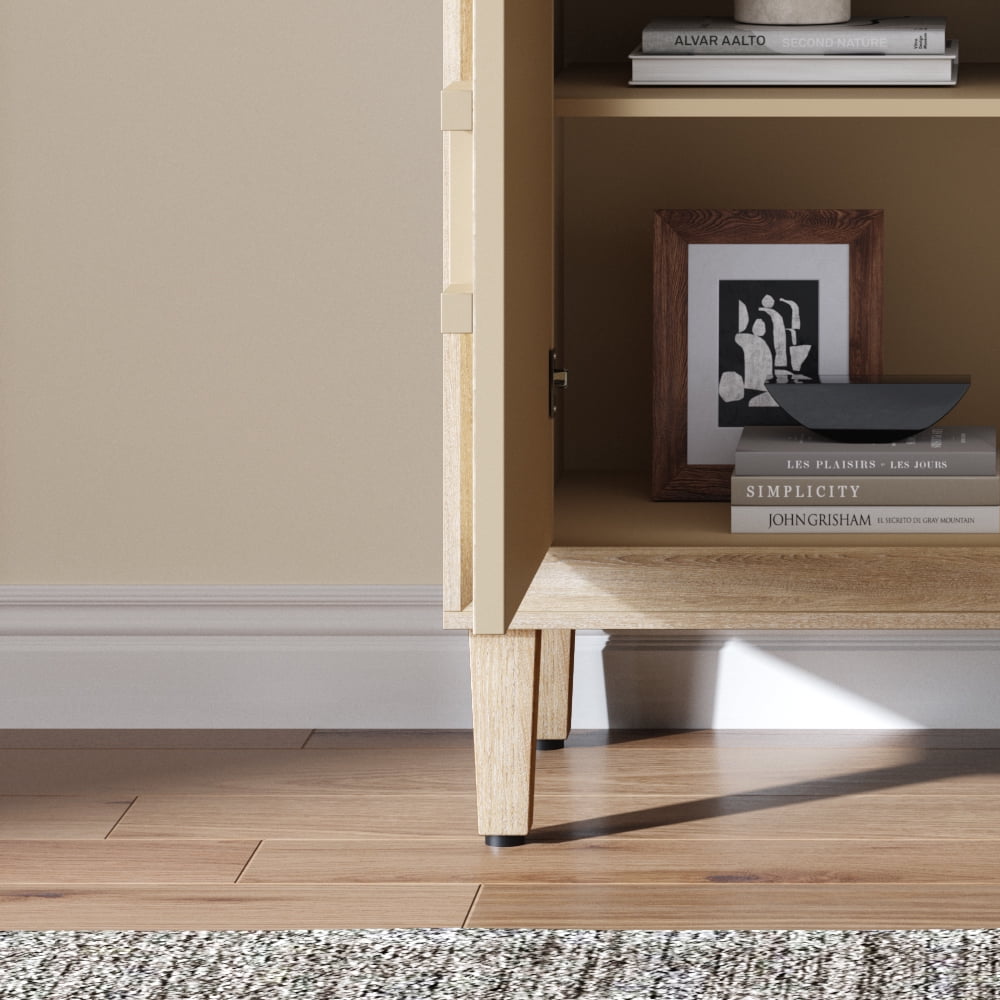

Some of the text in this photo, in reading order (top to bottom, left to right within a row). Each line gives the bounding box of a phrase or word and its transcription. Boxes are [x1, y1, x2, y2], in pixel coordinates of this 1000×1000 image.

[674, 34, 766, 46] ALVAR AALTO
[782, 37, 888, 48] SECOND NATURE
[787, 460, 810, 469] LES
[816, 460, 876, 469] PLAISIRS
[890, 460, 910, 469] LES
[914, 460, 948, 469] JOURS
[746, 485, 860, 498] SIMPLICITY
